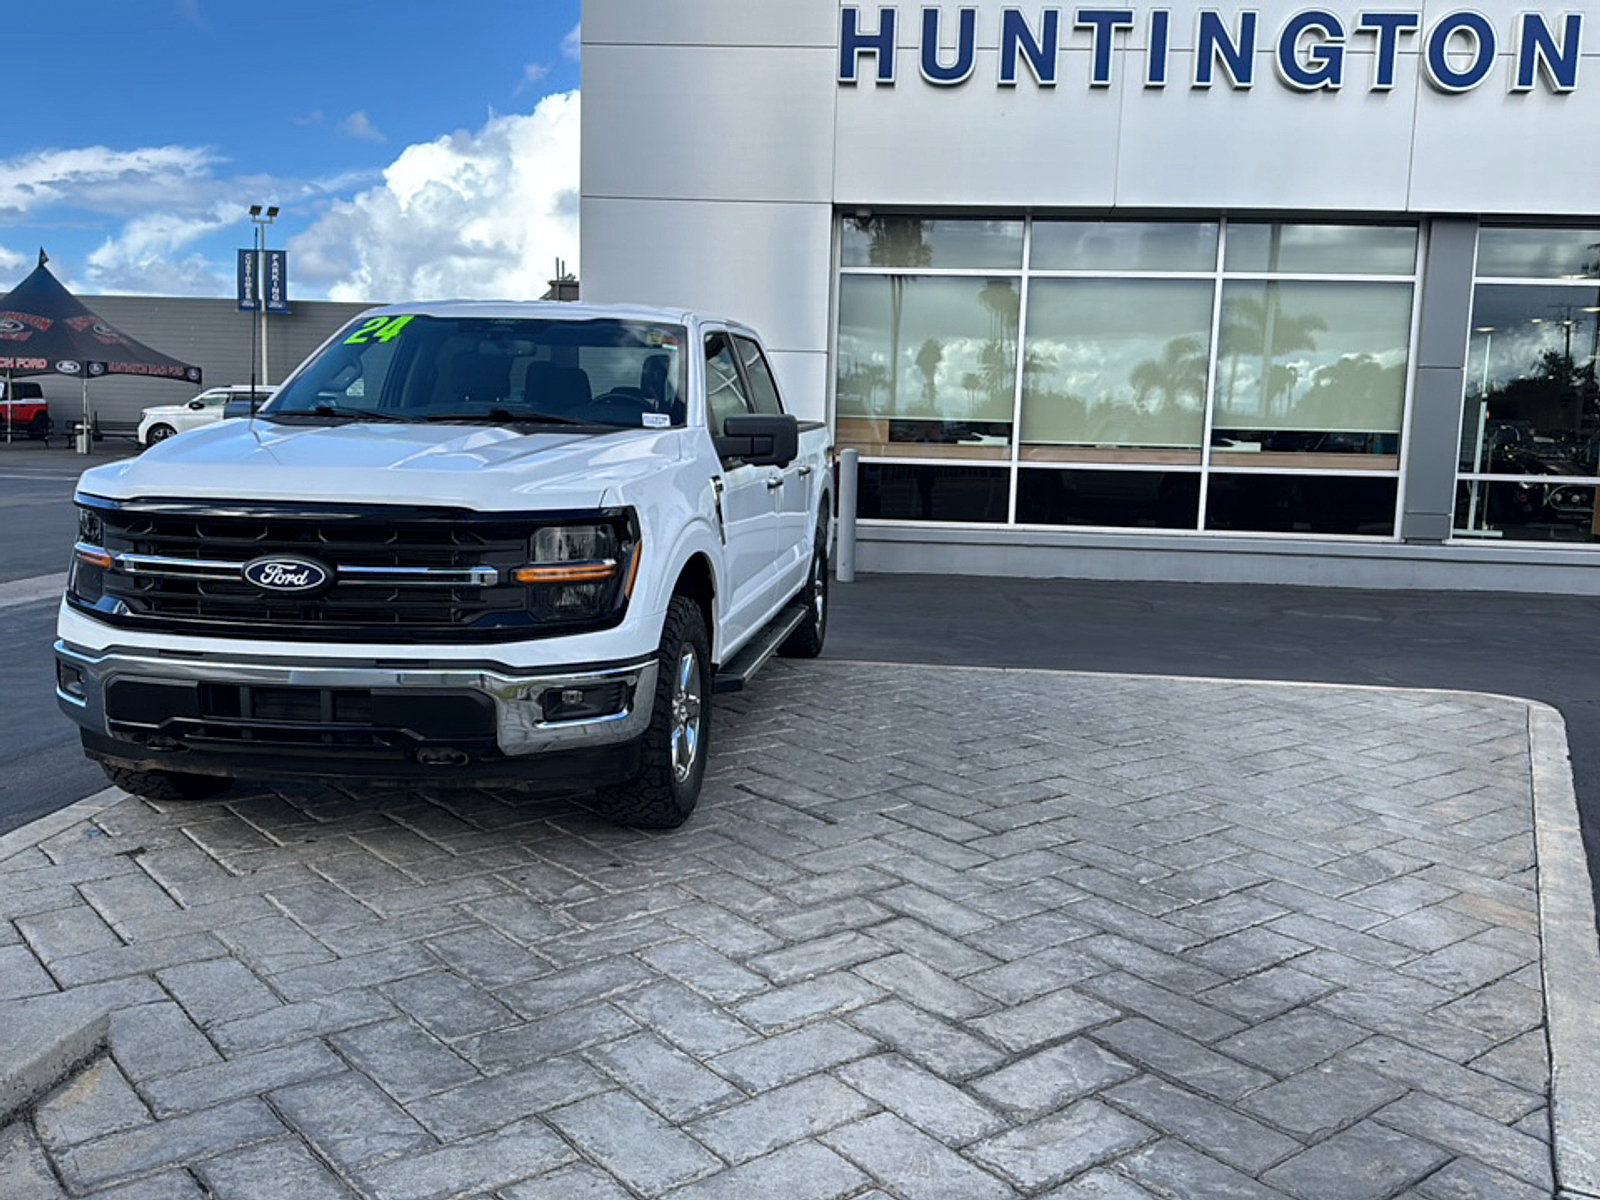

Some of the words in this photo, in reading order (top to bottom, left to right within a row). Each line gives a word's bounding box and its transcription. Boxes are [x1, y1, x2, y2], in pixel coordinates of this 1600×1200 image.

[838, 6, 1584, 93] HUNTINGTON
[271, 253, 280, 302] PARKING
[343, 315, 415, 345] 24
[16, 357, 48, 369] FORD
[260, 563, 310, 585] Ford
